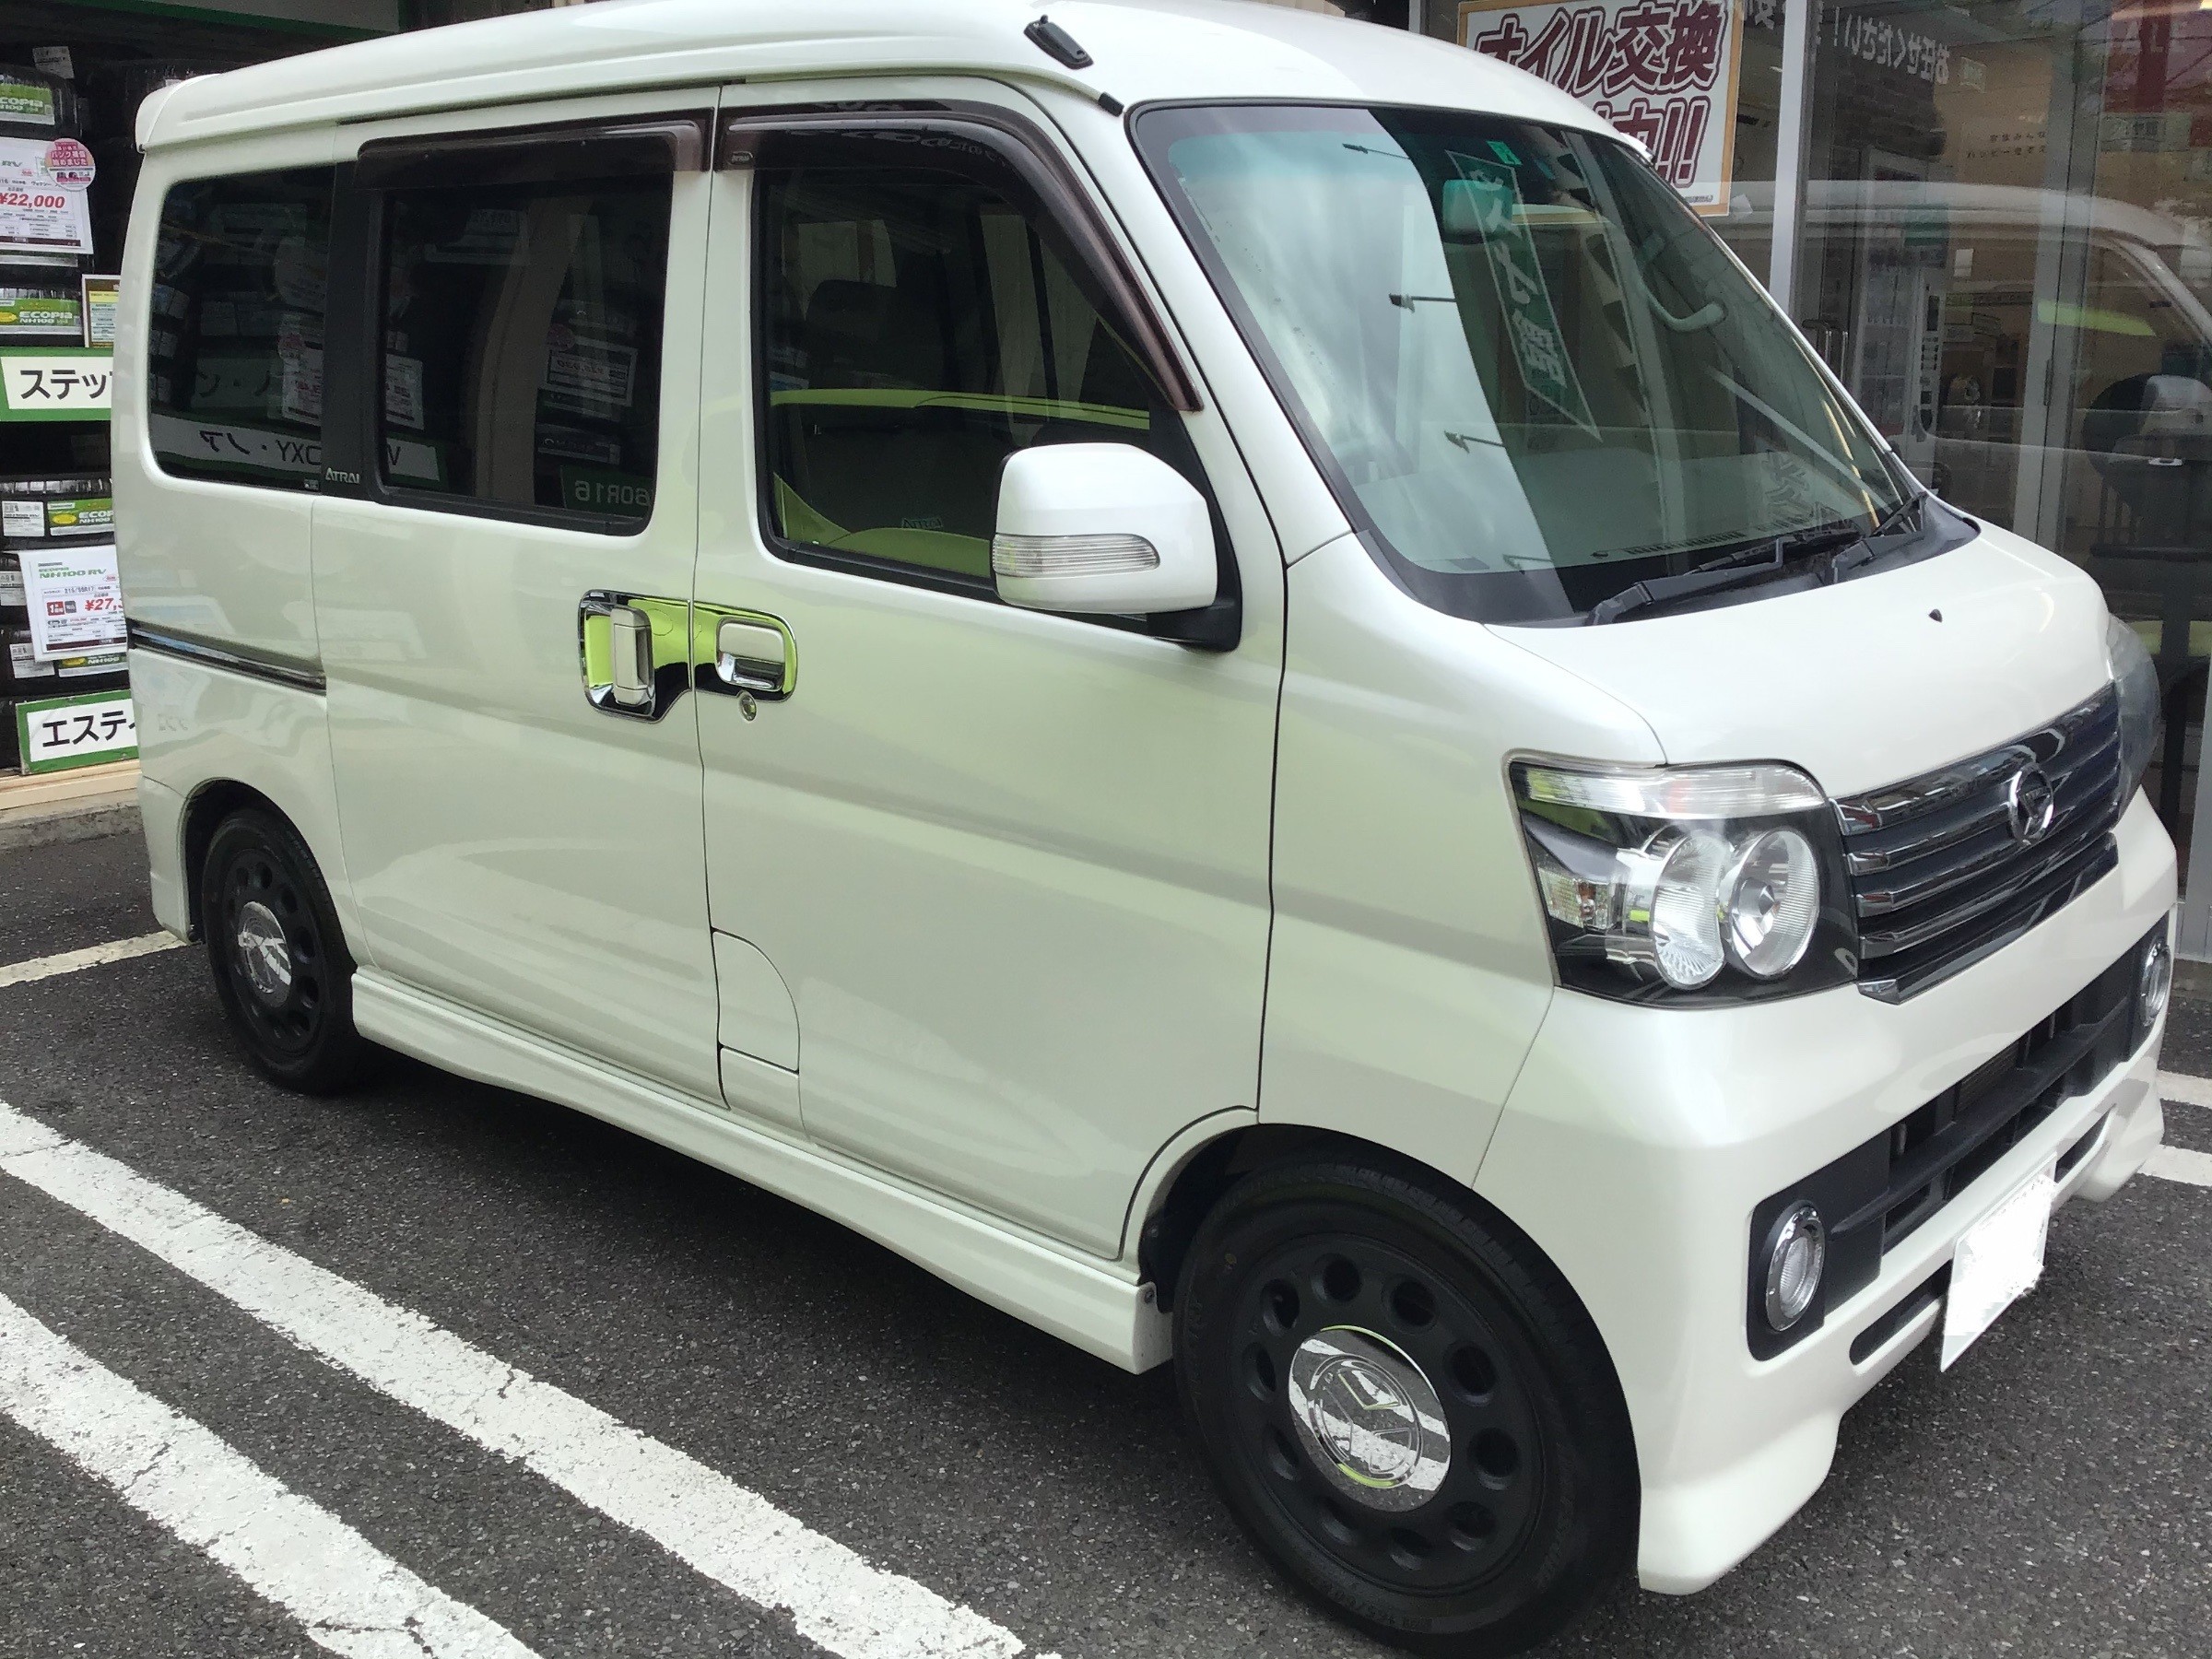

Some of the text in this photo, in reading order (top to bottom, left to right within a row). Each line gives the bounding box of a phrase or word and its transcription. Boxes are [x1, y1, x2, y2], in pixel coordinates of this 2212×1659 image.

[20, 370, 112, 400] ステッ
[324, 466, 360, 485] ATRAI
